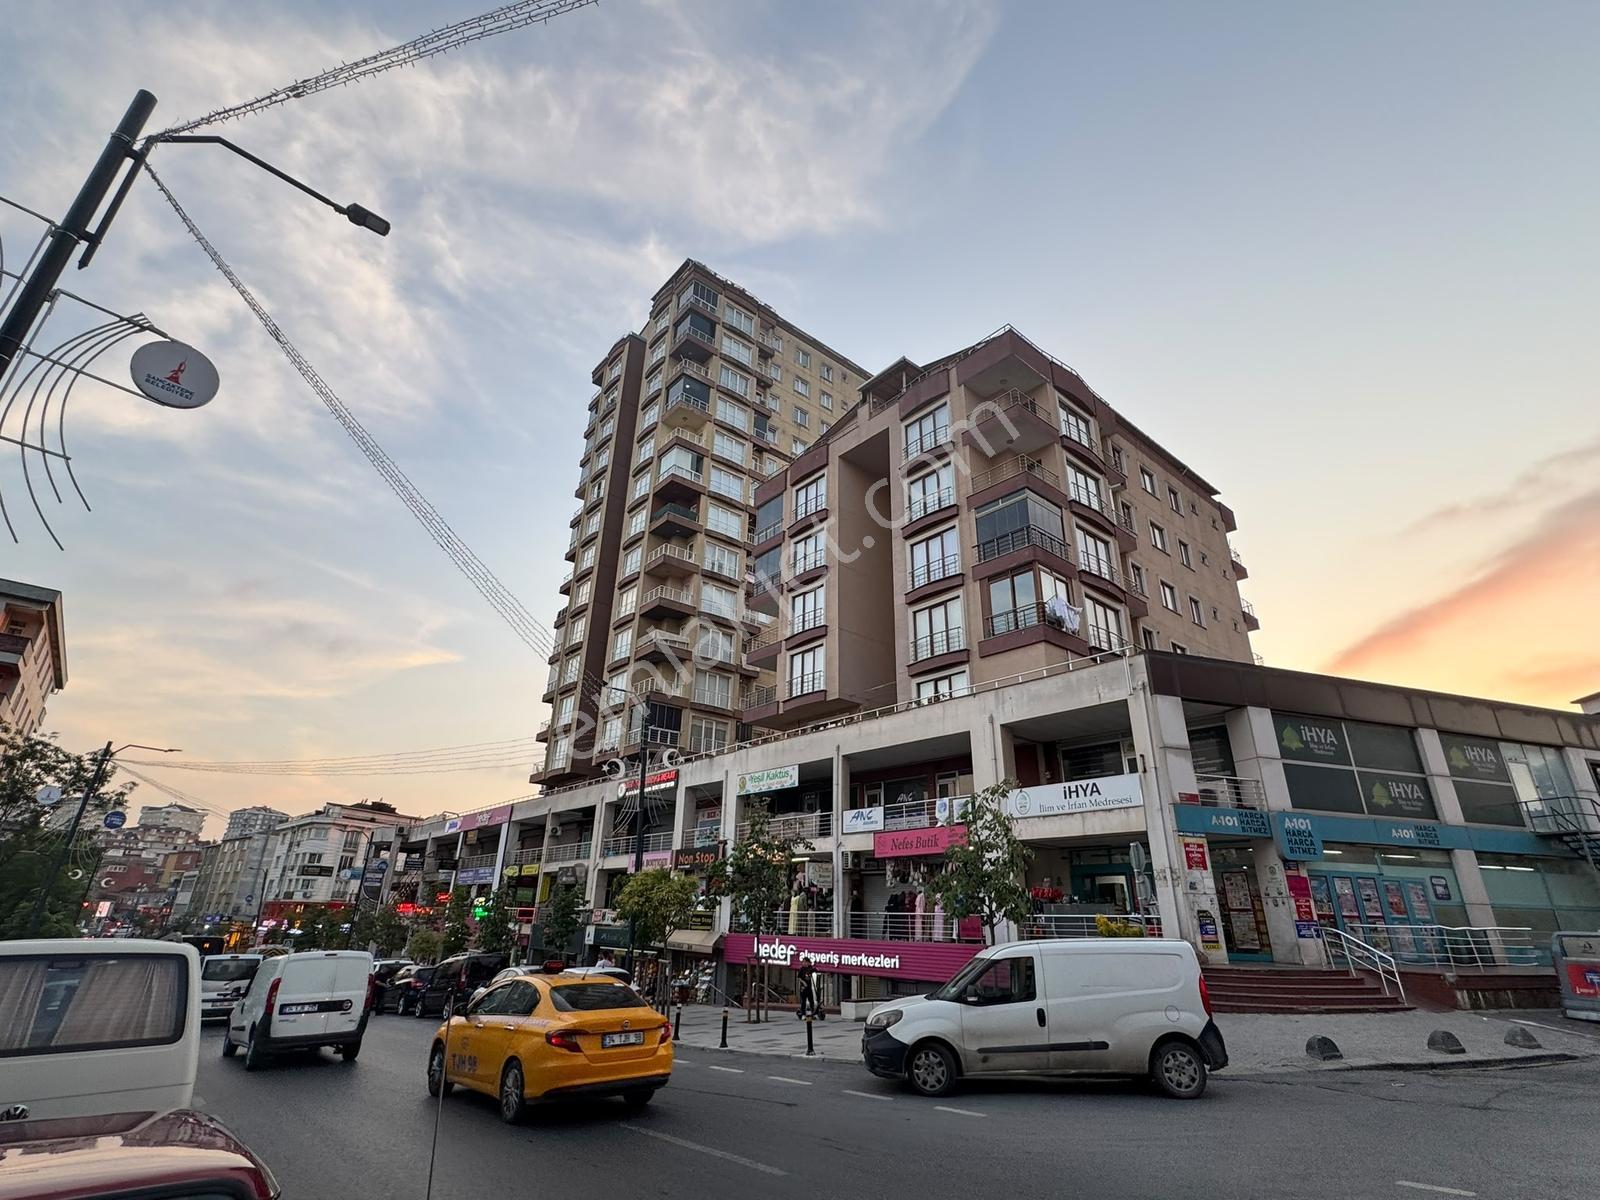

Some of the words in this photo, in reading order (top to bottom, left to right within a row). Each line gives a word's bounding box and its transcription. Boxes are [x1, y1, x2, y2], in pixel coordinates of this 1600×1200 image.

[1089, 796, 1133, 808] Medresesi
[849, 809, 874, 823] ANC
[1238, 811, 1265, 820] HARCA
[1240, 819, 1267, 827] HARCA
[1285, 829, 1314, 839] HARCA
[890, 837, 914, 851] Nefes
[915, 834, 940, 849] Butik
[1287, 838, 1316, 848] HARCA
[678, 853, 694, 864] Non
[695, 851, 715, 865] Stop
[754, 937, 797, 965] hedef
[841, 952, 900, 969] merkezleri
